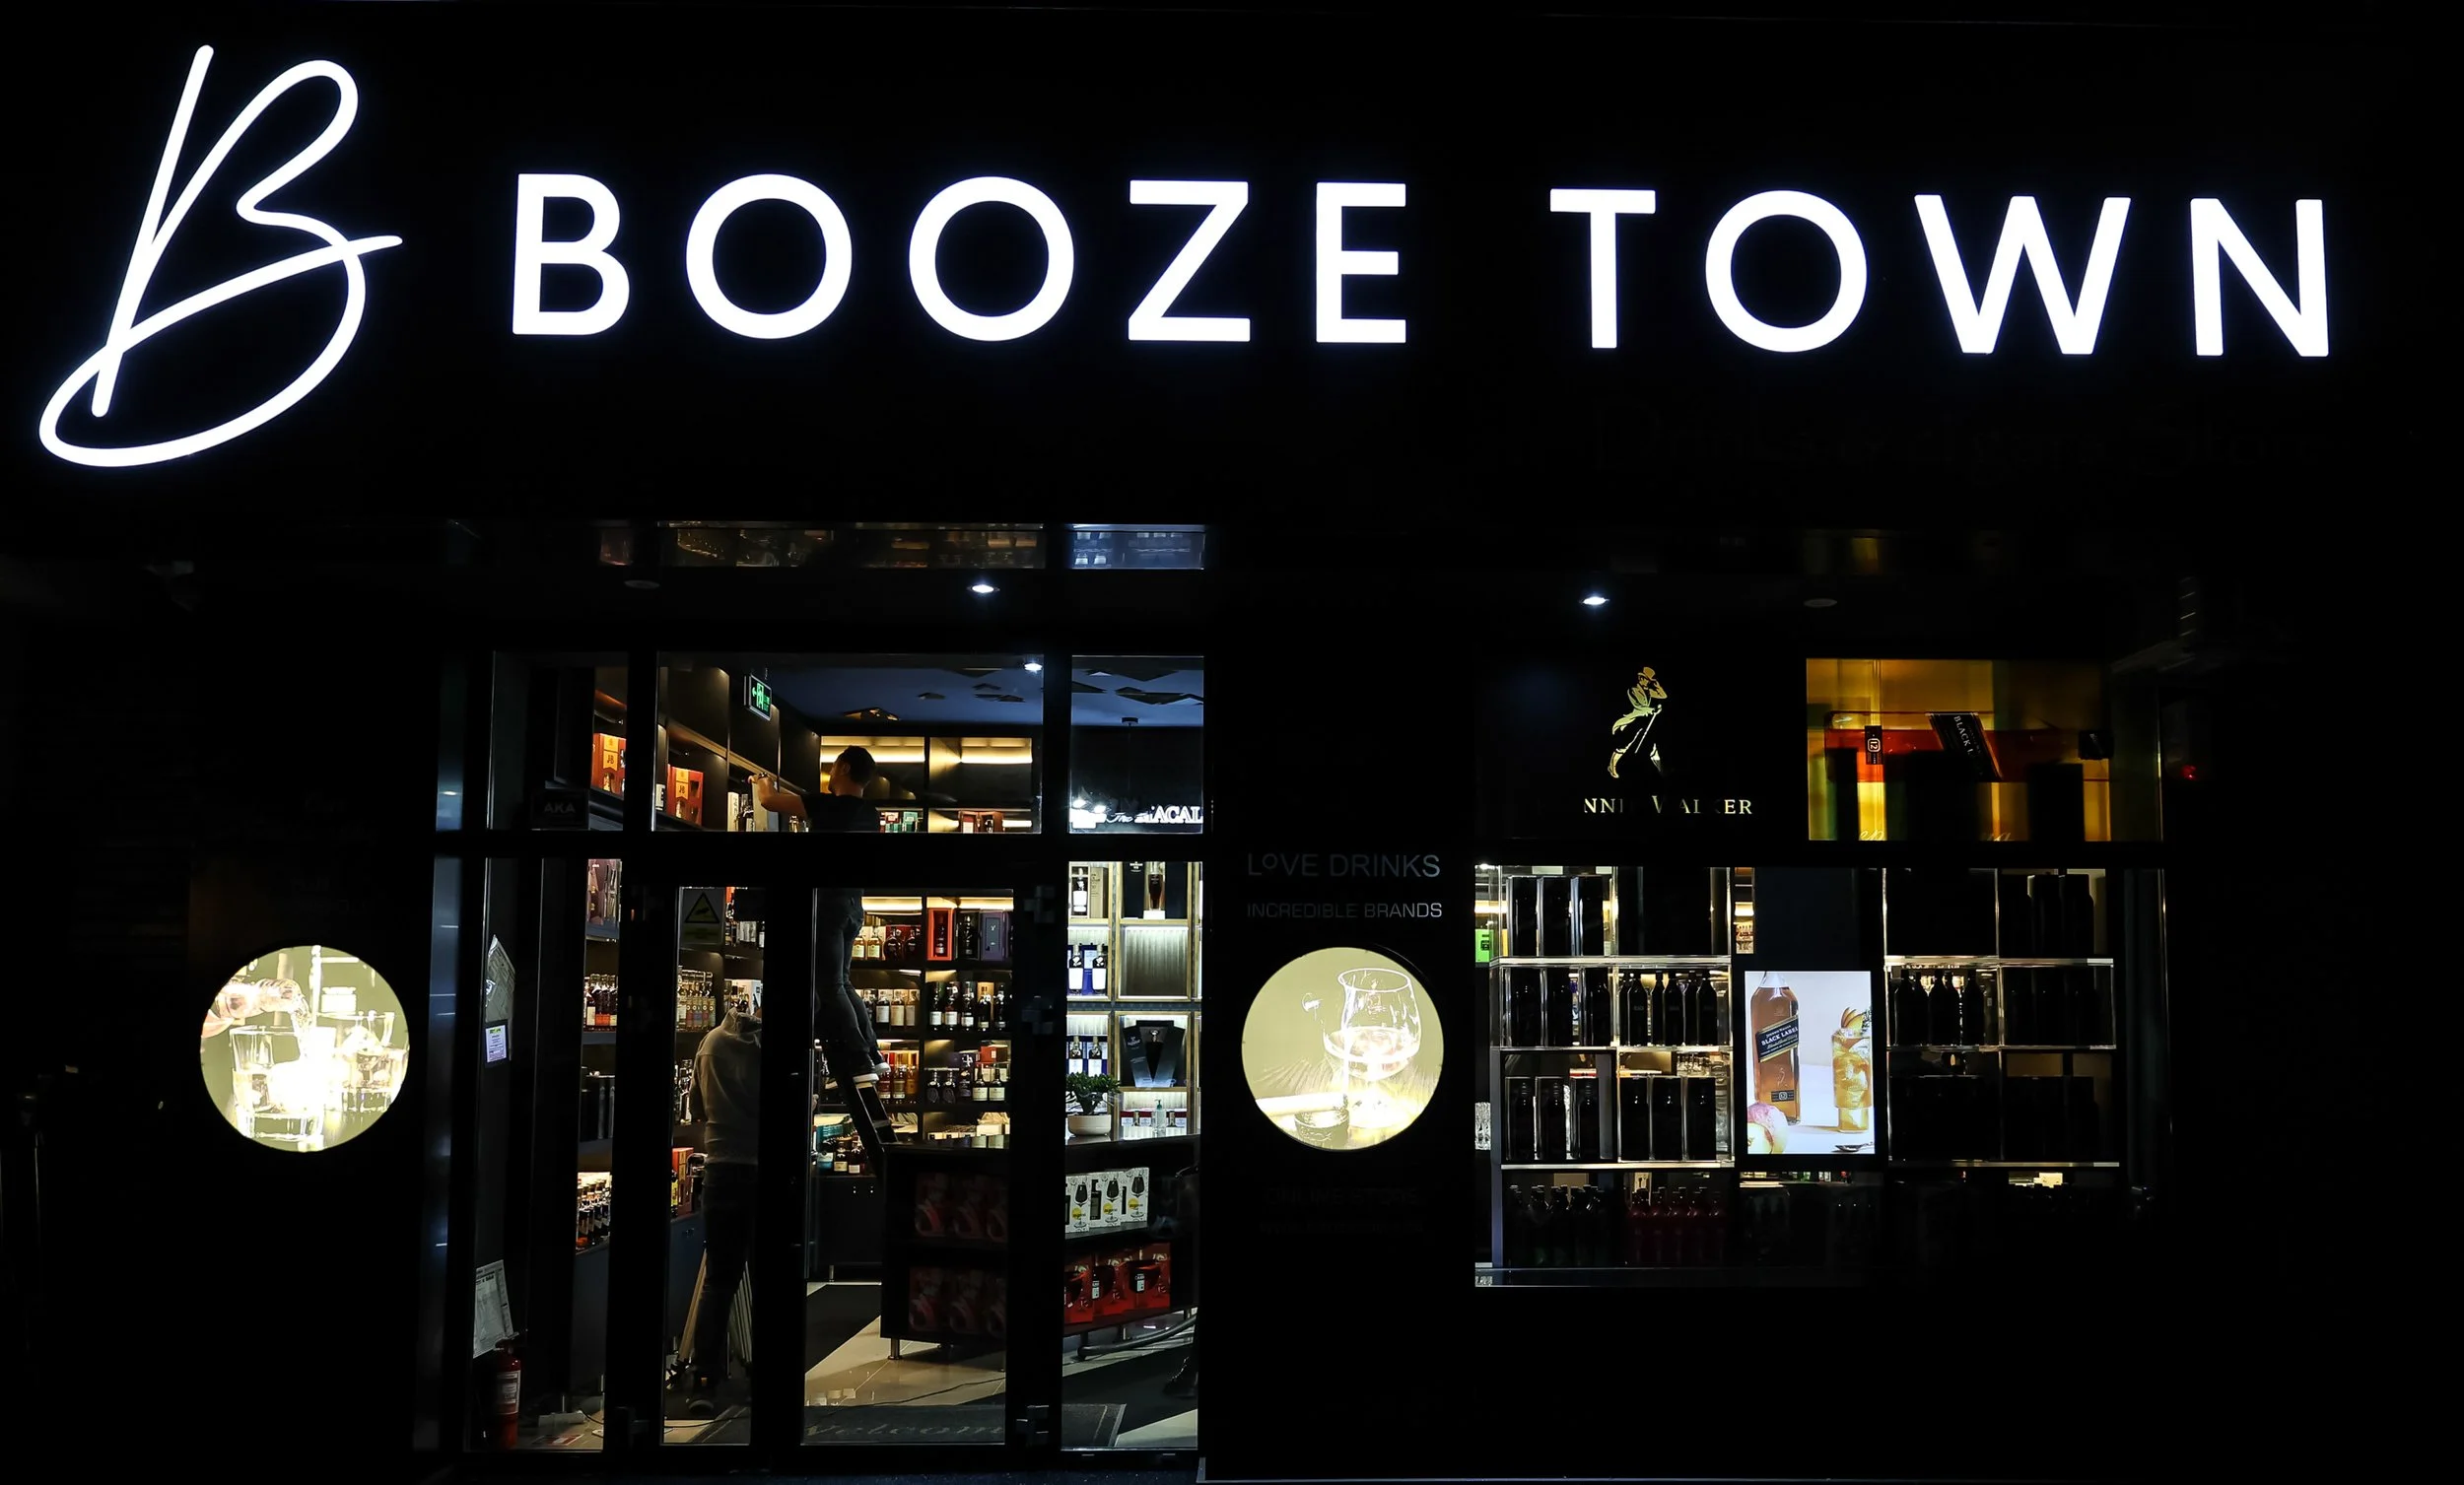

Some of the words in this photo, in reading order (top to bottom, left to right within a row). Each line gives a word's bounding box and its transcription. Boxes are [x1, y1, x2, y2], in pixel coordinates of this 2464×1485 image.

[39, 45, 402, 466] B
[513, 174, 1406, 342] BOOZE
[1550, 189, 2328, 357] TOWN
[1953, 715, 1971, 747] BLACK
[543, 801, 577, 814] AKA
[1247, 852, 1320, 878] LOVE
[1328, 852, 1442, 879] DRINKS
[1246, 901, 1360, 919] INCREDIBLE
[1364, 901, 1444, 919] BRANDS
[1760, 1034, 1781, 1046] BLACK
[1781, 1026, 1799, 1038] LABEL
